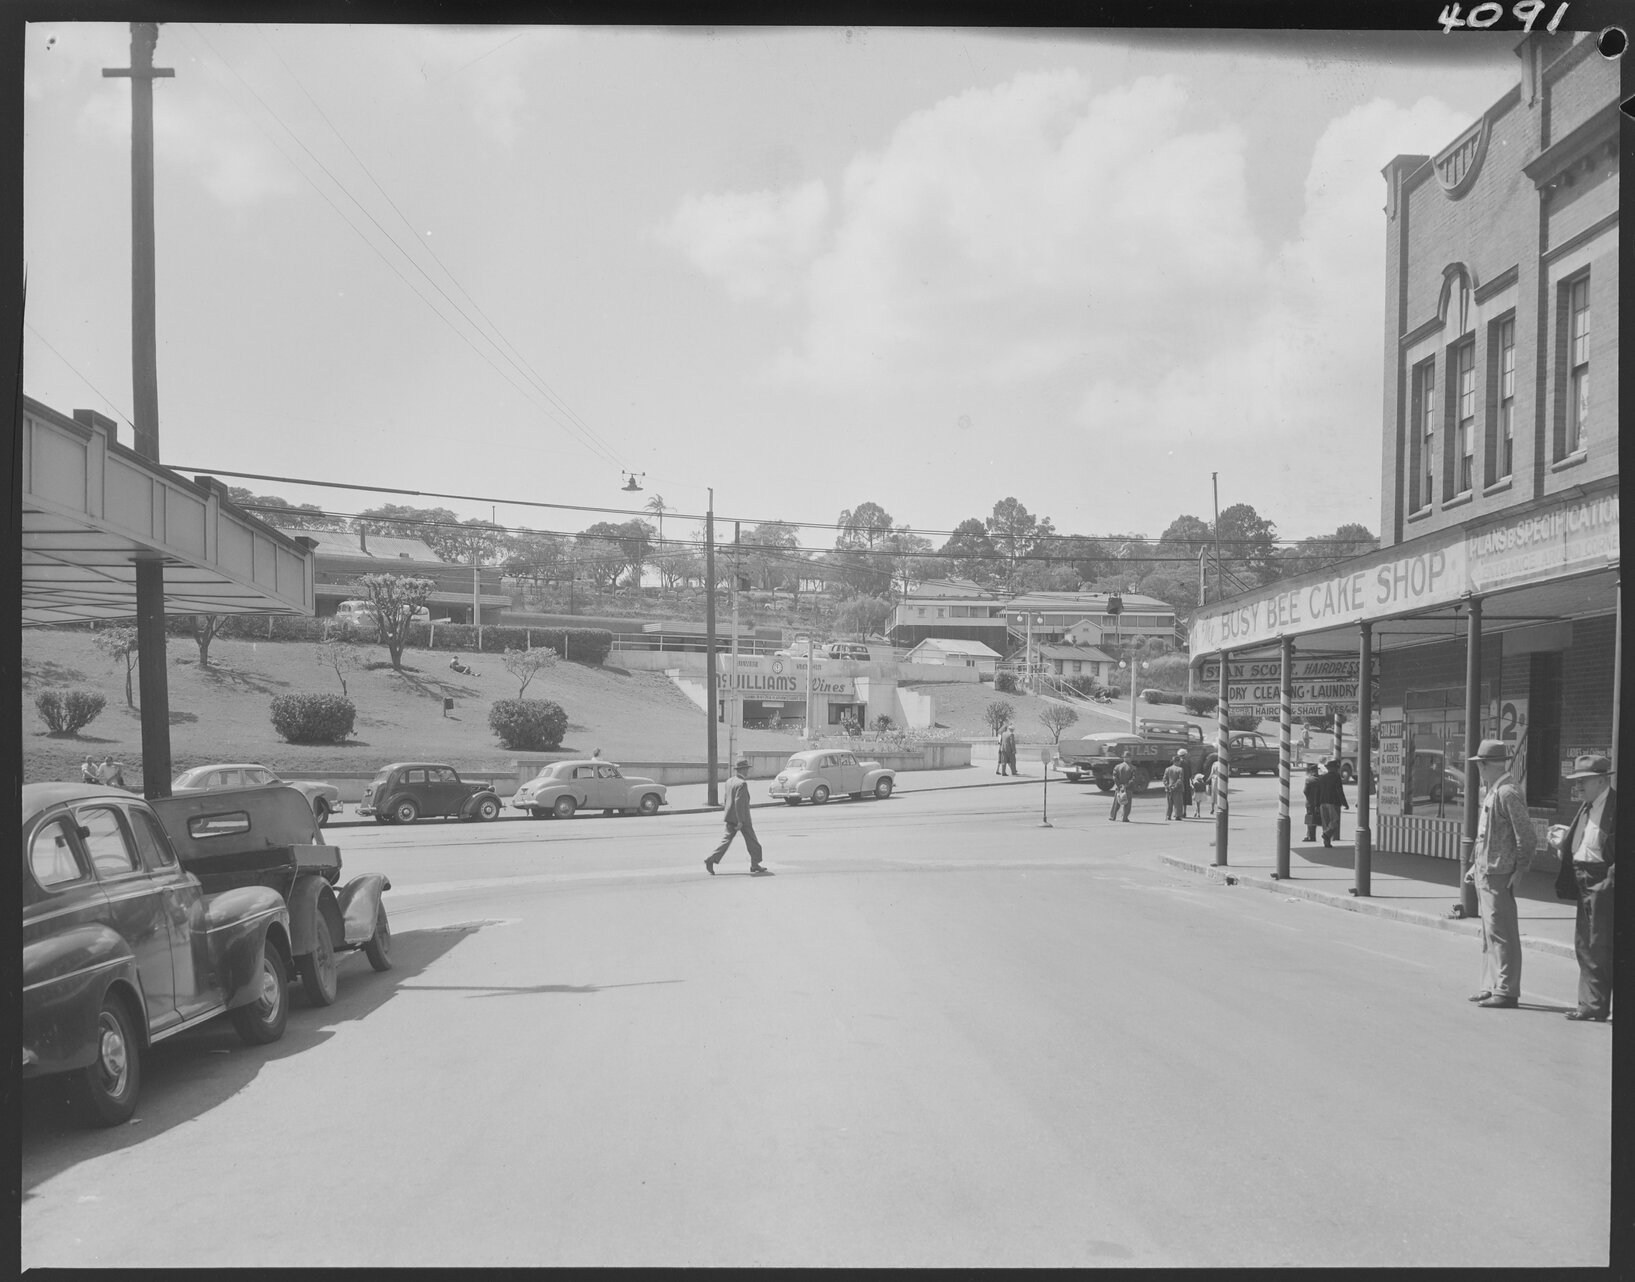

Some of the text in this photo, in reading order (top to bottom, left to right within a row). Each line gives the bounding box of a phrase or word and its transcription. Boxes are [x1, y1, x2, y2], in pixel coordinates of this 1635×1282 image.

[1437, 0, 1570, 35] 4091
[1468, 528, 1507, 562] PLANS
[1222, 602, 1260, 641] BUSY
[1267, 589, 1301, 630] BEE
[1309, 572, 1364, 620] CAKE
[1375, 549, 1446, 605] SHOP
[1305, 661, 1377, 676] HAIRDRESSR
[1229, 683, 1359, 700] DRY CLEANG LAUNDRY
[1256, 706, 1281, 716] HAIRC
[1297, 706, 1323, 715] SHAVE
[1124, 744, 1159, 756] ATLAS
